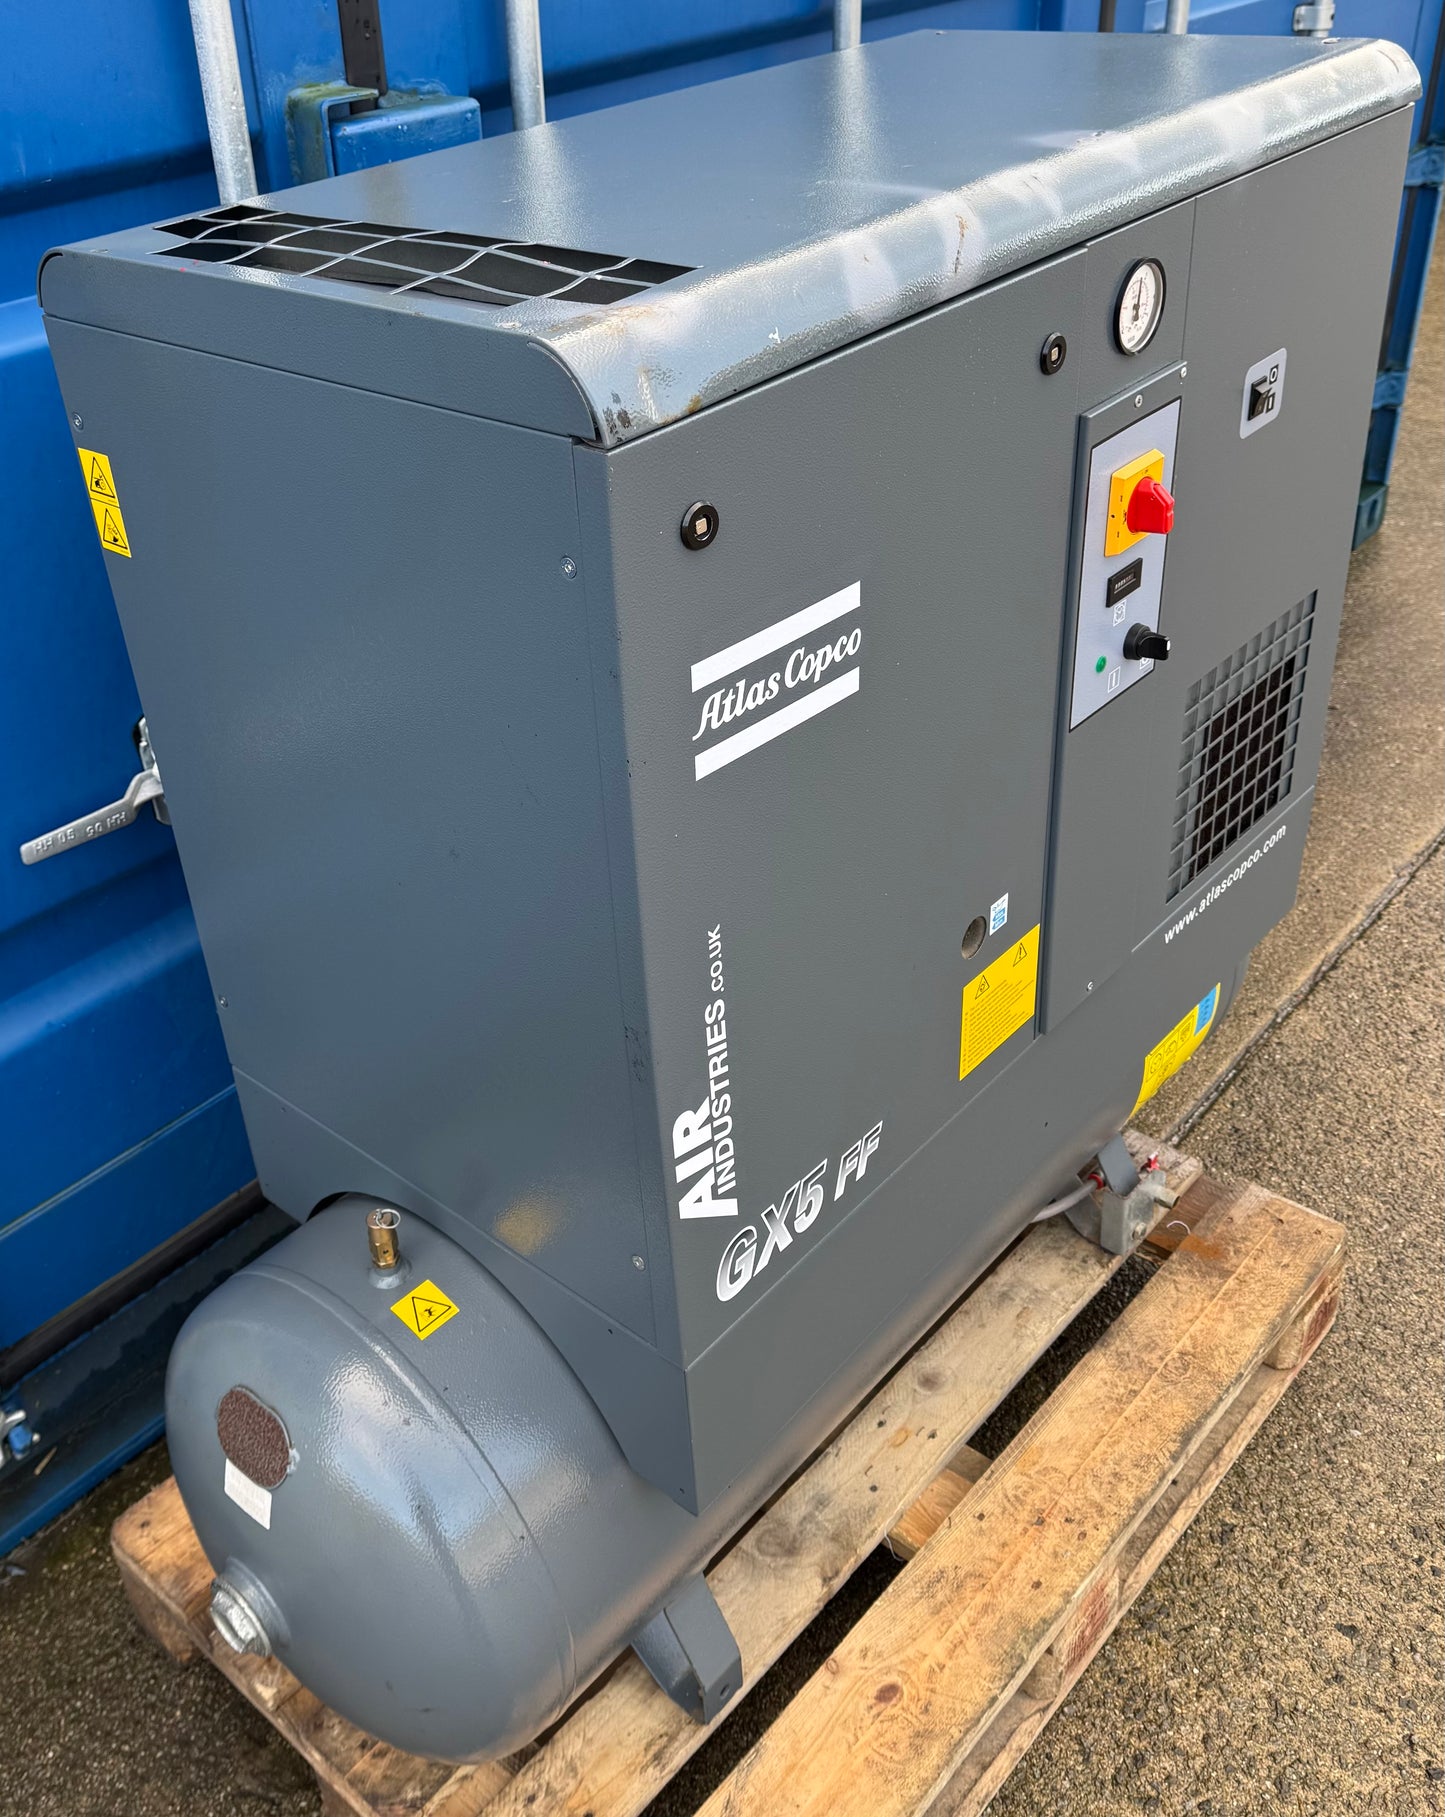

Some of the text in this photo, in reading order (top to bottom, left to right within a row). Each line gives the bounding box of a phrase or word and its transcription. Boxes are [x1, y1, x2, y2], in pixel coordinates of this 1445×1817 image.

[692, 628, 862, 741] Atlas Copco
[1164, 825, 1287, 944] www.atlascopco.com
[672, 1095, 739, 1220] AIR
[704, 998, 737, 1196] INDUSTRIES
[715, 1120, 884, 1303] GX5 FF
